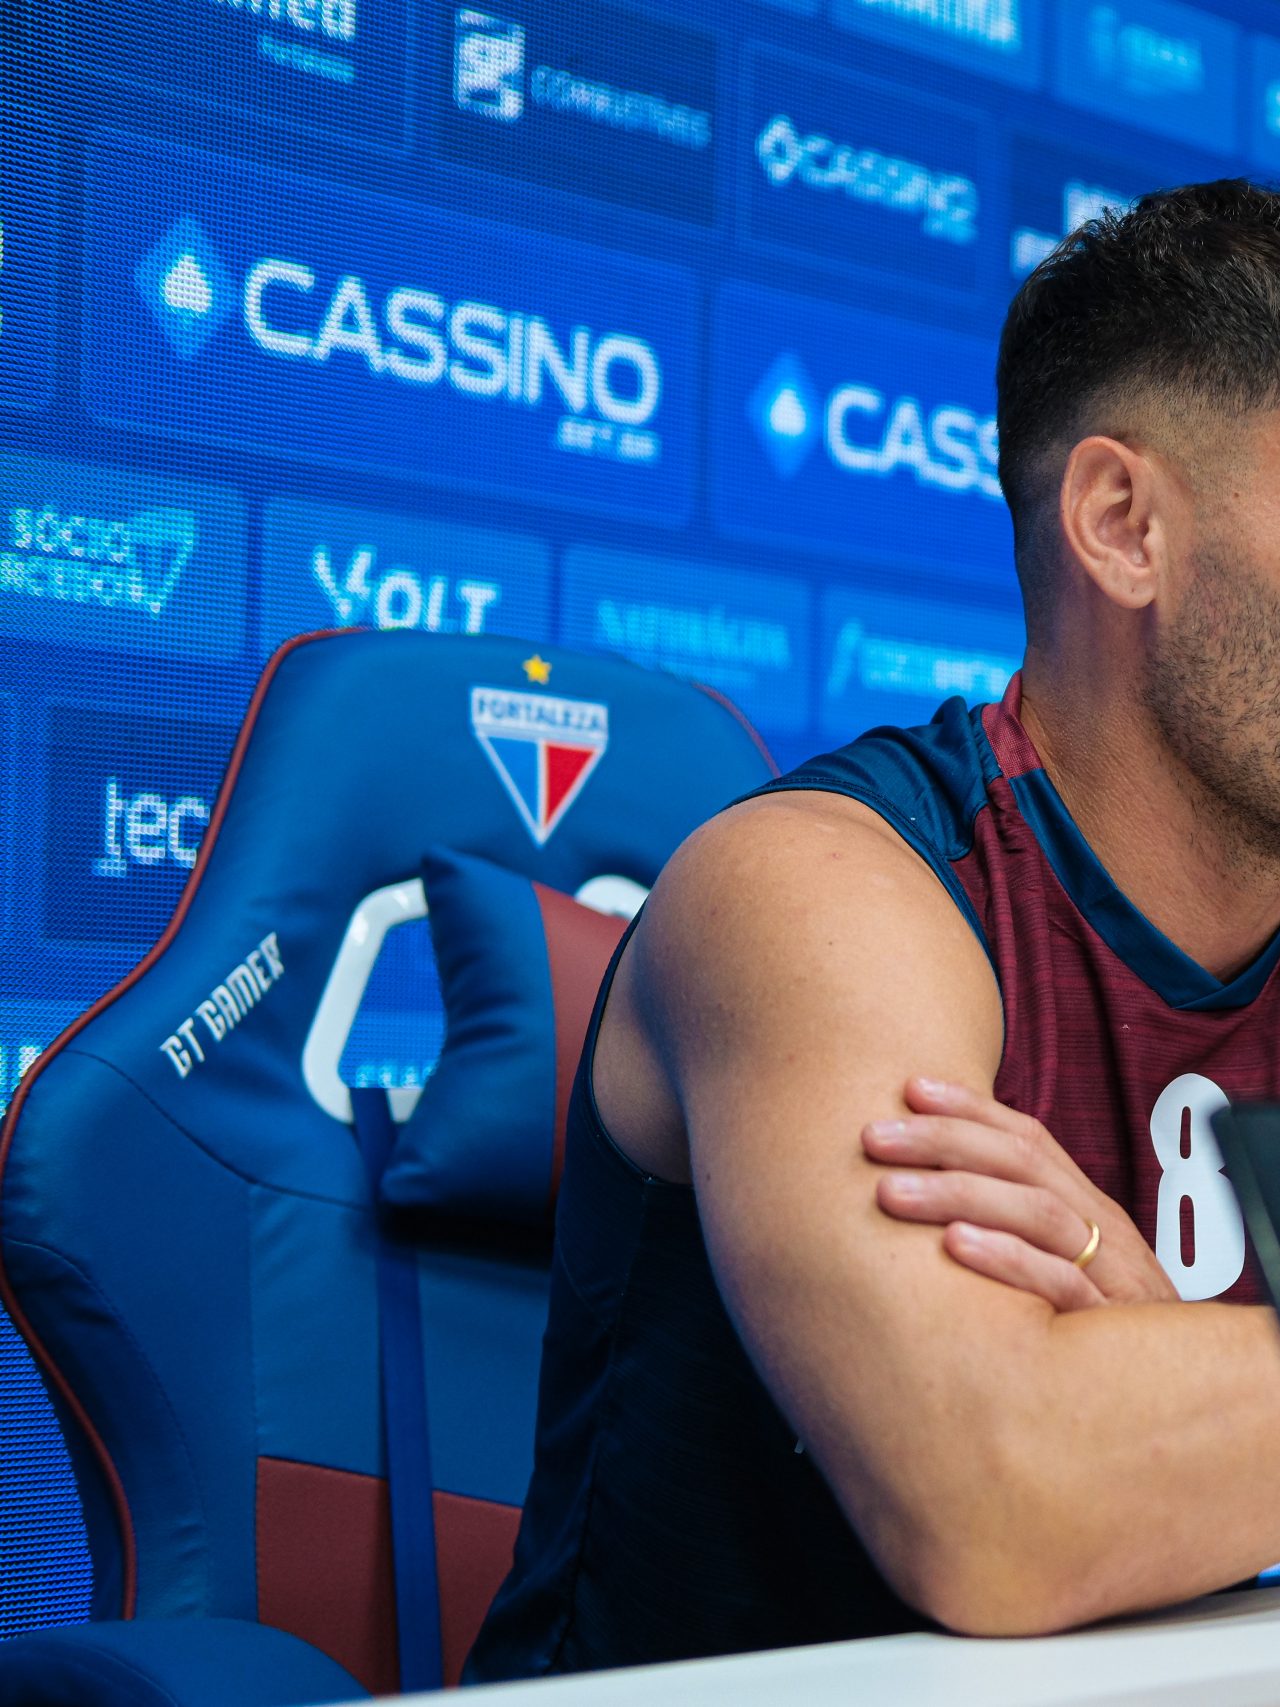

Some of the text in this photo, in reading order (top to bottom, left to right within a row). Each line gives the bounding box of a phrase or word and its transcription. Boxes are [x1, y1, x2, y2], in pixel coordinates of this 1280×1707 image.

[245, 256, 661, 428] CASSINO
[312, 545, 498, 633] VOLT
[1150, 1073, 1246, 1301] 8
